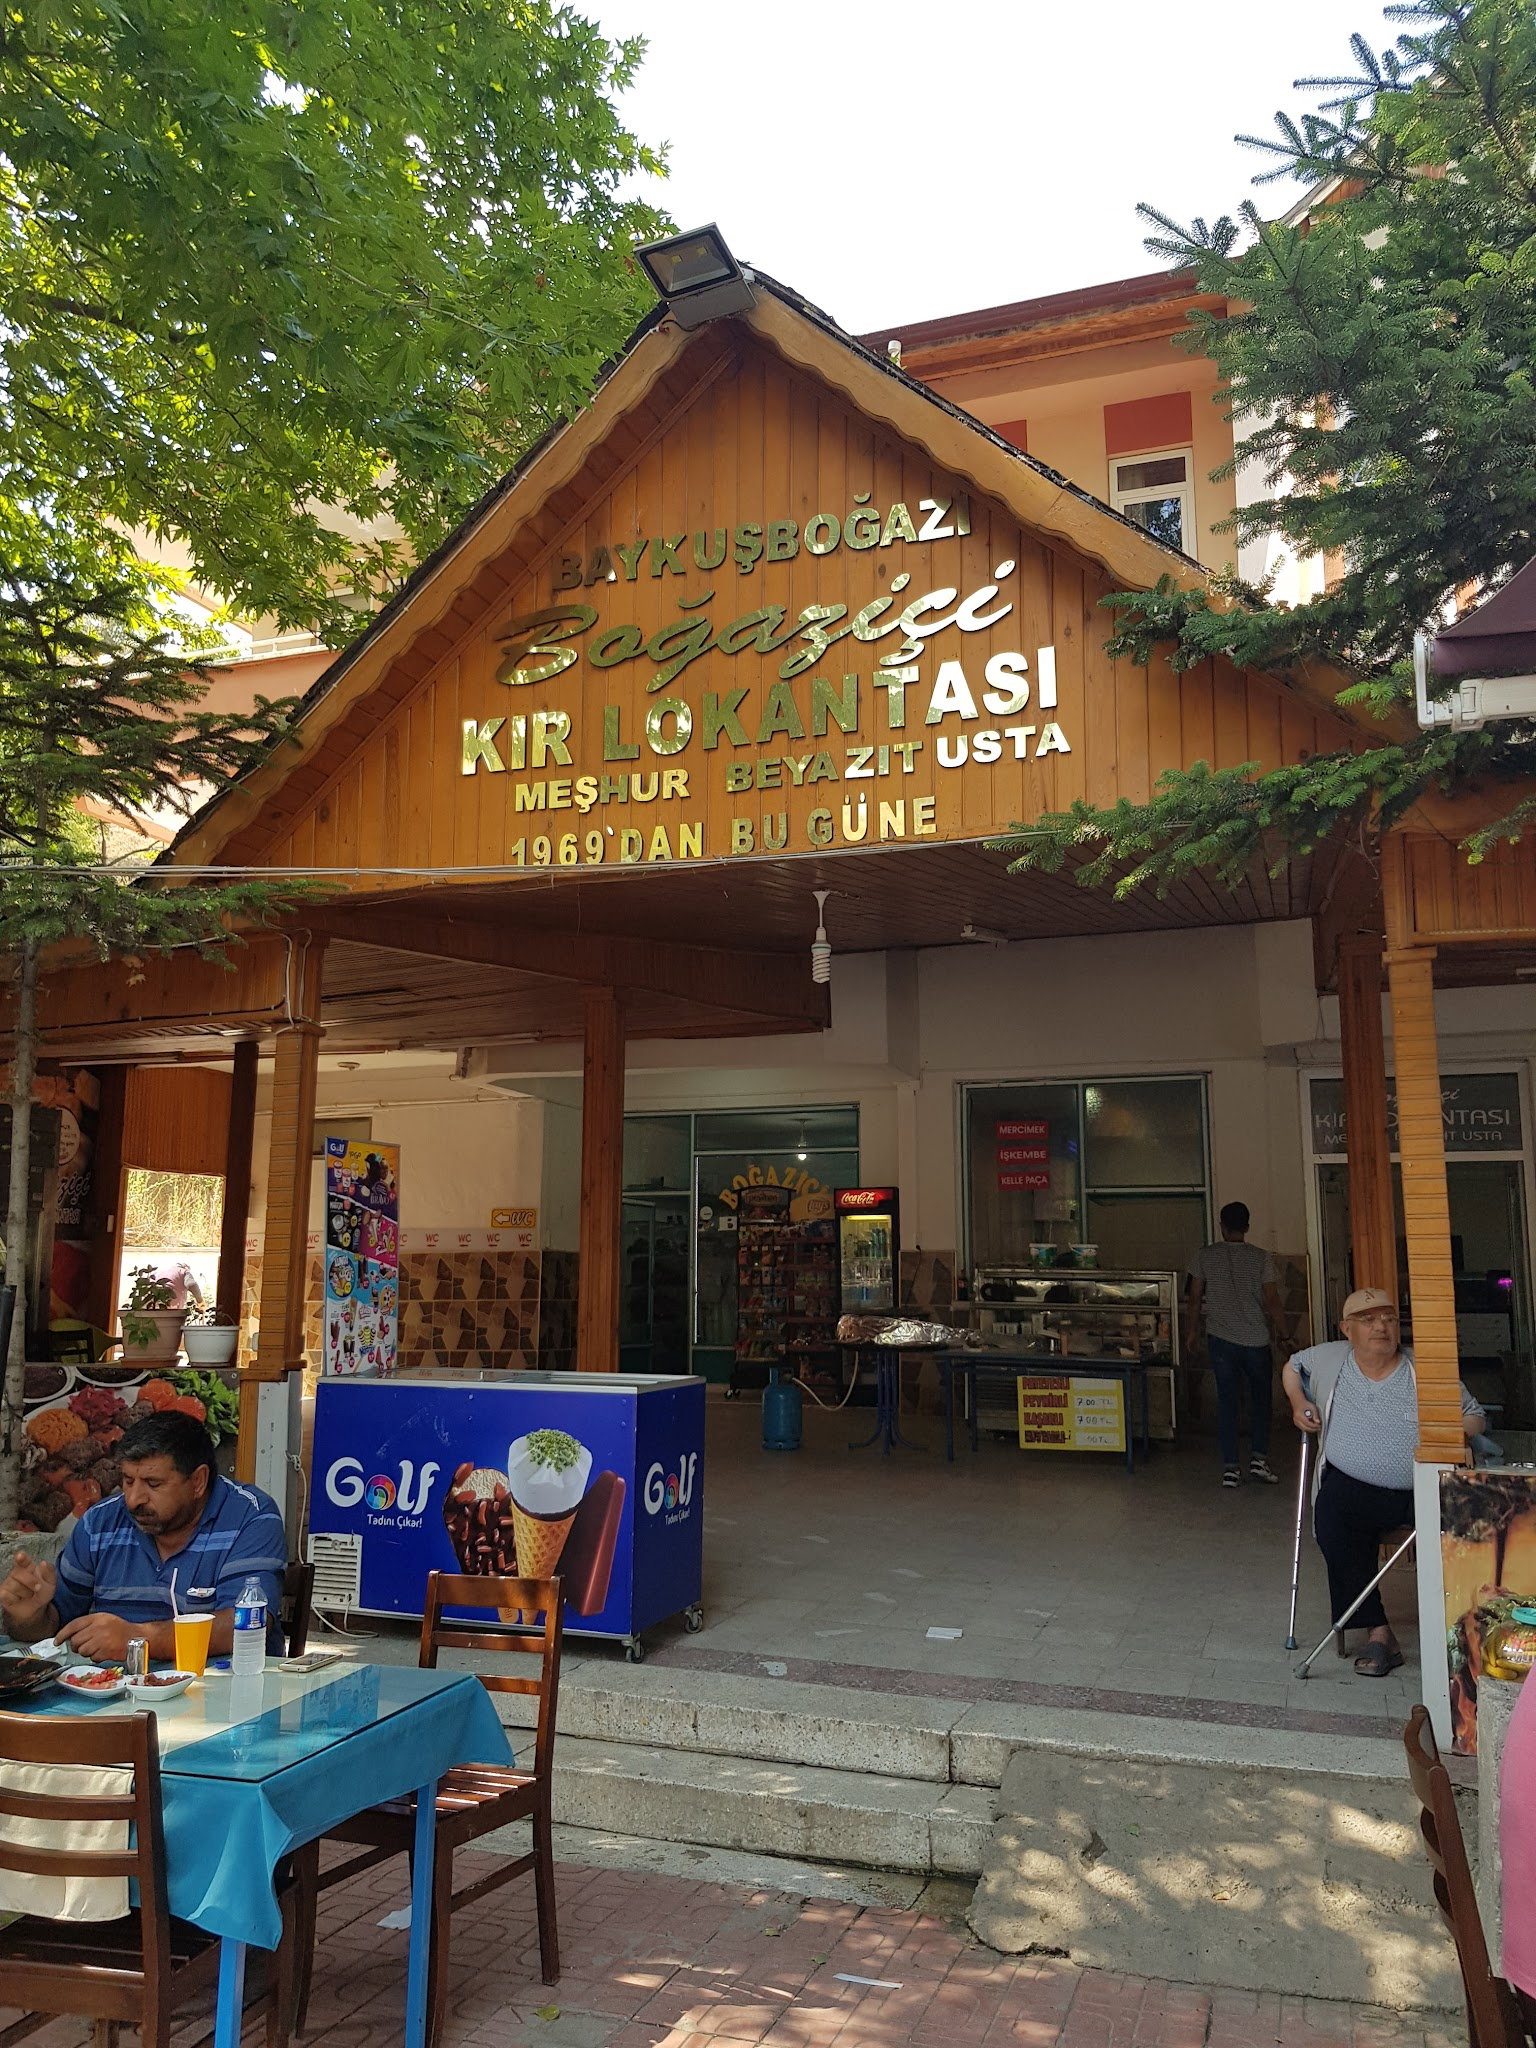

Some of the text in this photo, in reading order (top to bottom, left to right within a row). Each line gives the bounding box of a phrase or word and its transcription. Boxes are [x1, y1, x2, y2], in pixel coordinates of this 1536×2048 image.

[551, 493, 971, 590] BAYKUŞBOĞAZI
[496, 560, 1017, 693] Boğaziçi
[461, 646, 1059, 776] KIR LOKANTASI
[514, 723, 1071, 814] MEŞHUR BEYAZIT USTA
[731, 810, 788, 856] BU
[808, 793, 937, 846] GÜNE
[999, 1124, 1046, 1134] MERCİMEK
[1462, 1130, 1503, 1141] USTA
[1000, 1149, 1047, 1161] İŞKEMBE
[1001, 1175, 1048, 1186] KELLE PAÇA
[511, 1211, 534, 1225] WC
[425, 1233, 440, 1242] WC
[458, 1233, 472, 1242] WC
[486, 1233, 500, 1242] WC
[518, 1233, 533, 1242] WC
[325, 1456, 440, 1515] Golf
[644, 1452, 697, 1515] Golf
[367, 1513, 423, 1530] Tadını Çıkar!
